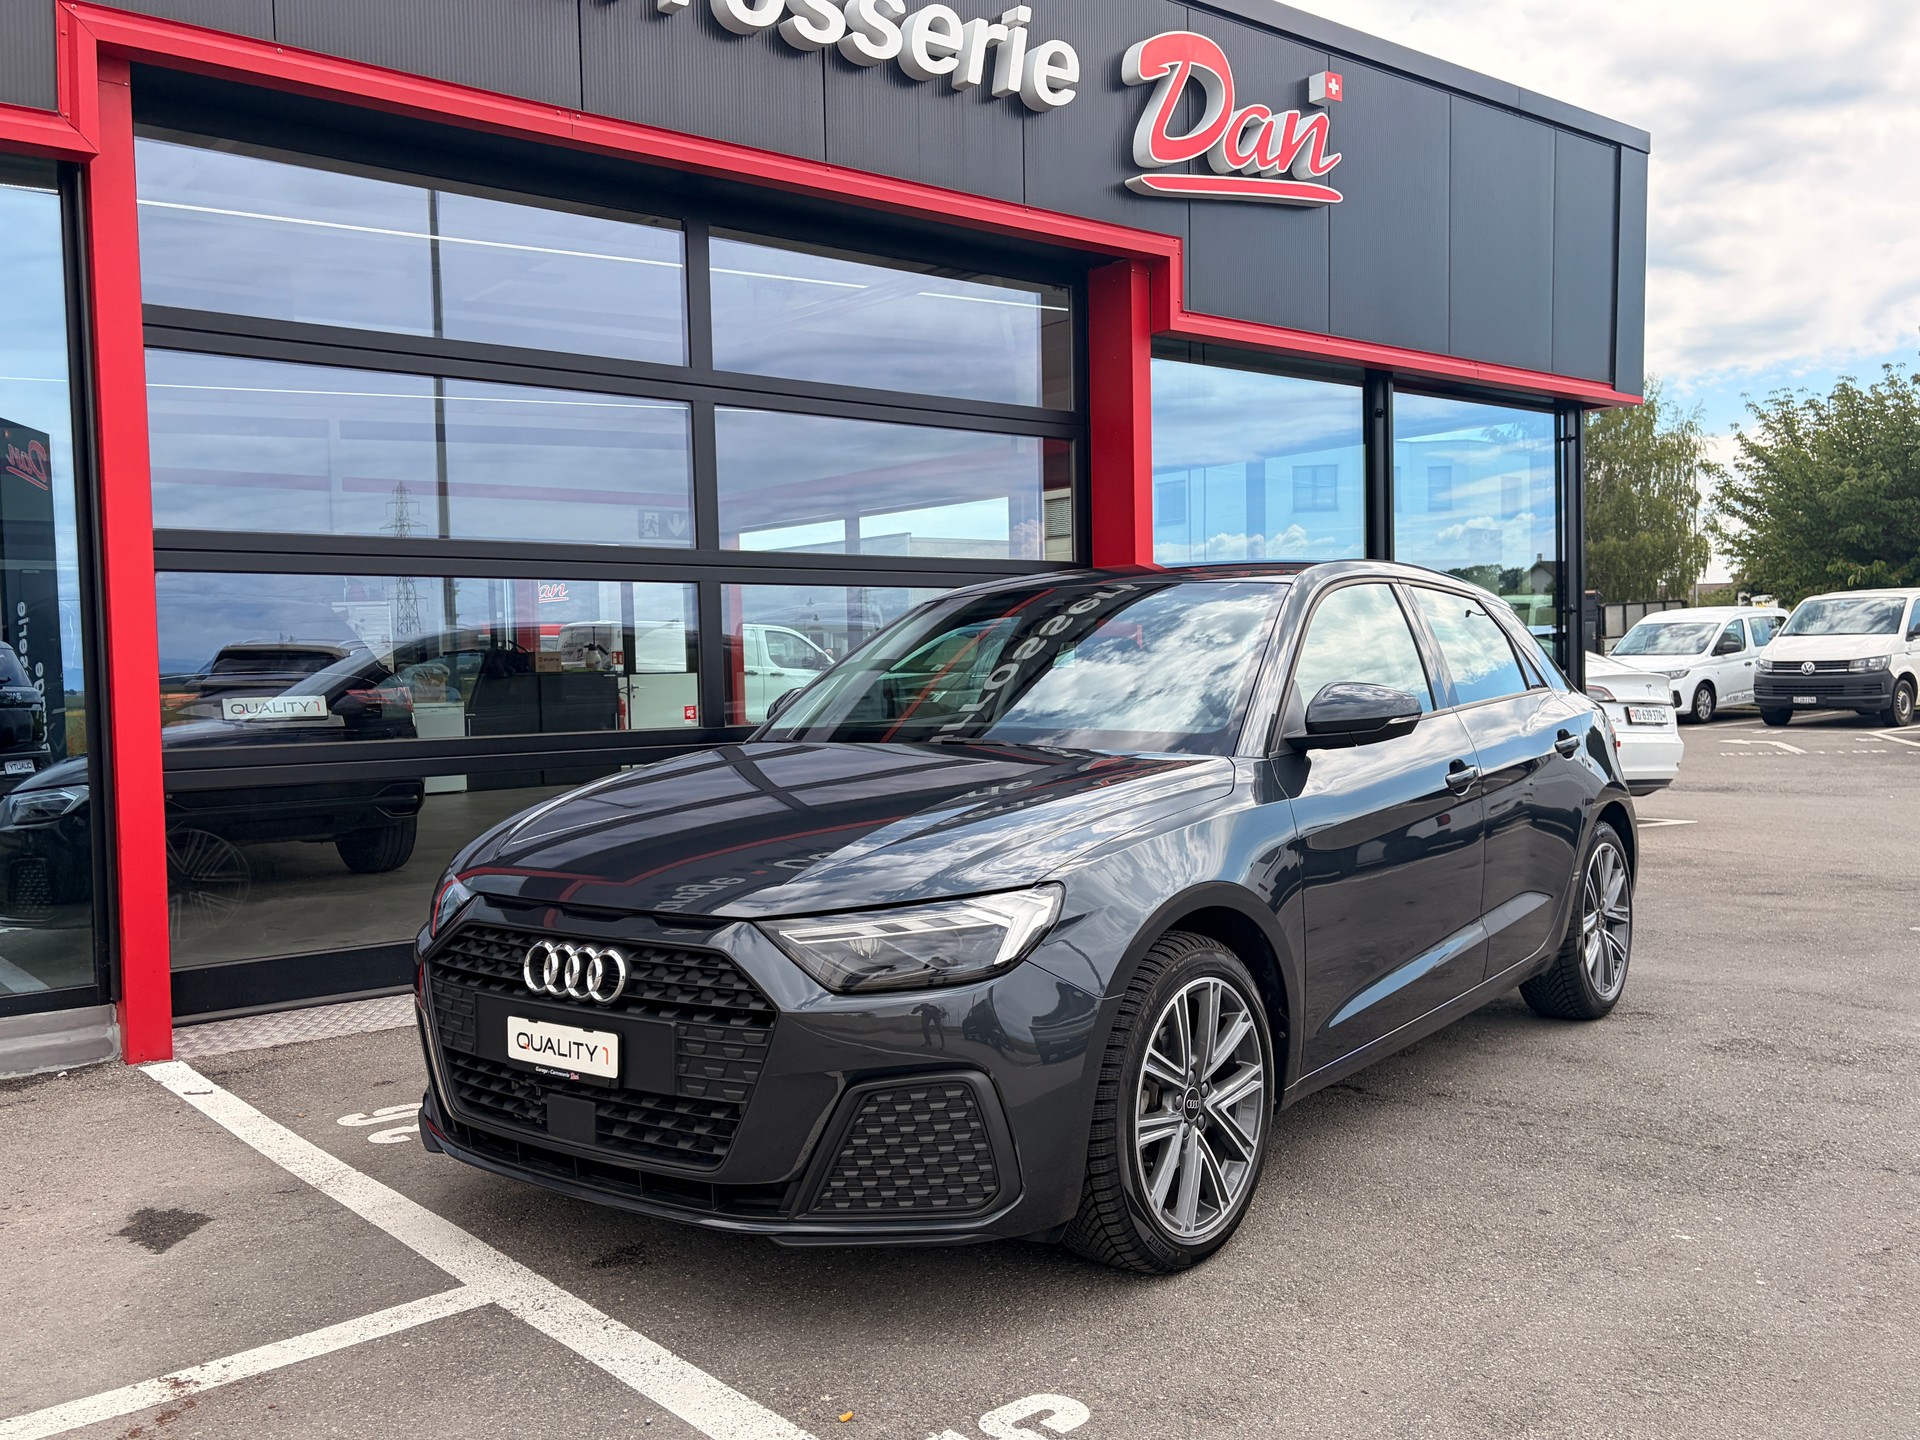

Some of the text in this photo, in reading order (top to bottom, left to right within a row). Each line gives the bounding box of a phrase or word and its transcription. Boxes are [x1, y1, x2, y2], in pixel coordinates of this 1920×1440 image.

[658, 0, 1342, 181] sserie Dan
[538, 581, 569, 597] an
[230, 701, 321, 715] QUALITY 1
[516, 1031, 610, 1066] QUALITY 1
